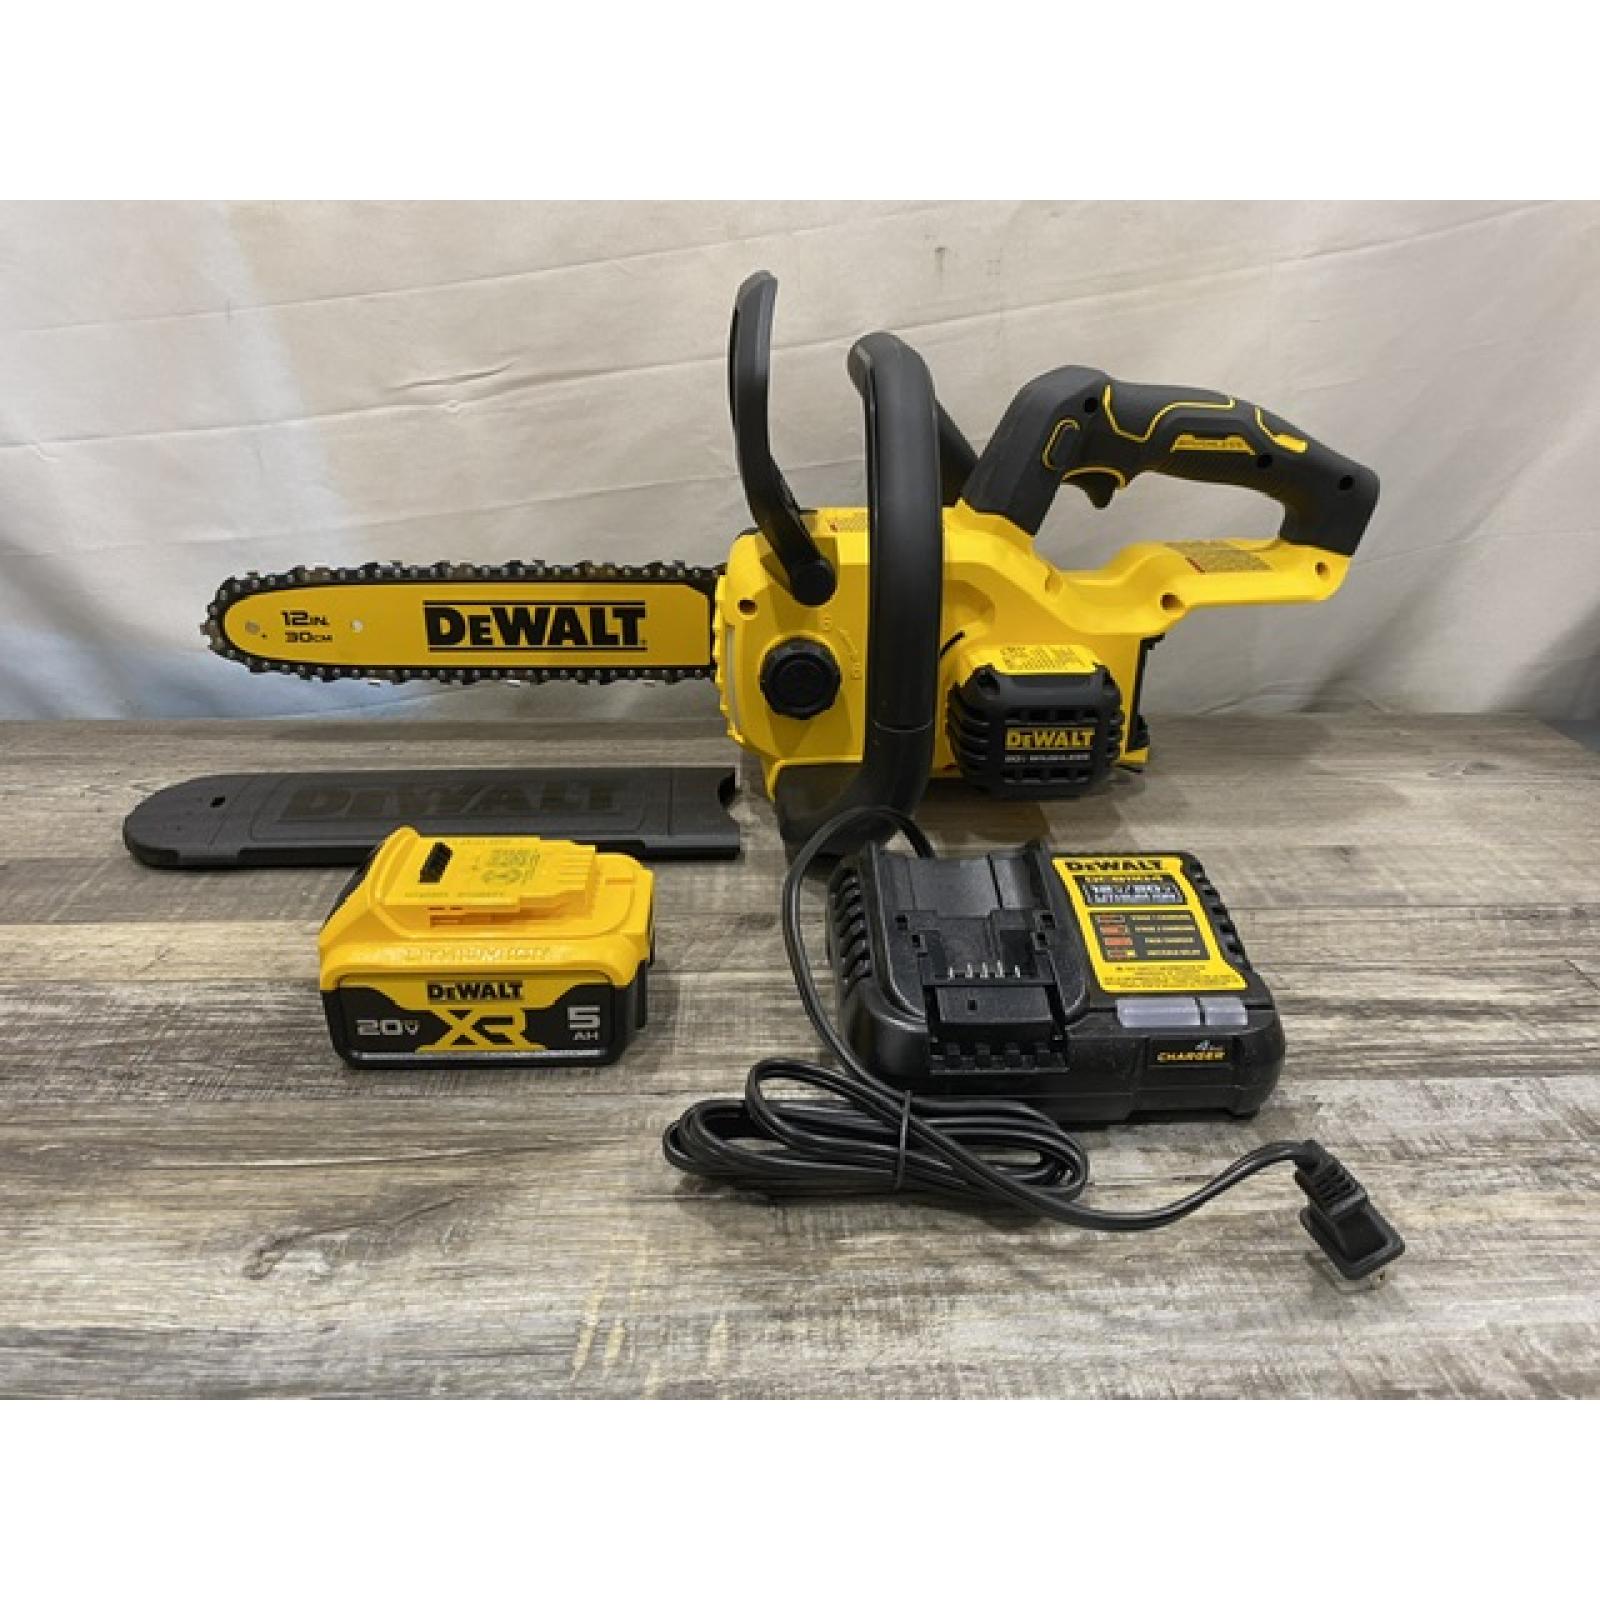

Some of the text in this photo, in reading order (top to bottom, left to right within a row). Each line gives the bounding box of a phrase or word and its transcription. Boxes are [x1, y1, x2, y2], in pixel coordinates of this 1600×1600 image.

[424, 604, 647, 649] DEWALT
[1005, 727, 1096, 751] DEWALT
[427, 981, 523, 1001] DEWALT
[567, 1004, 601, 1029] 5
[414, 1008, 548, 1052] XR
